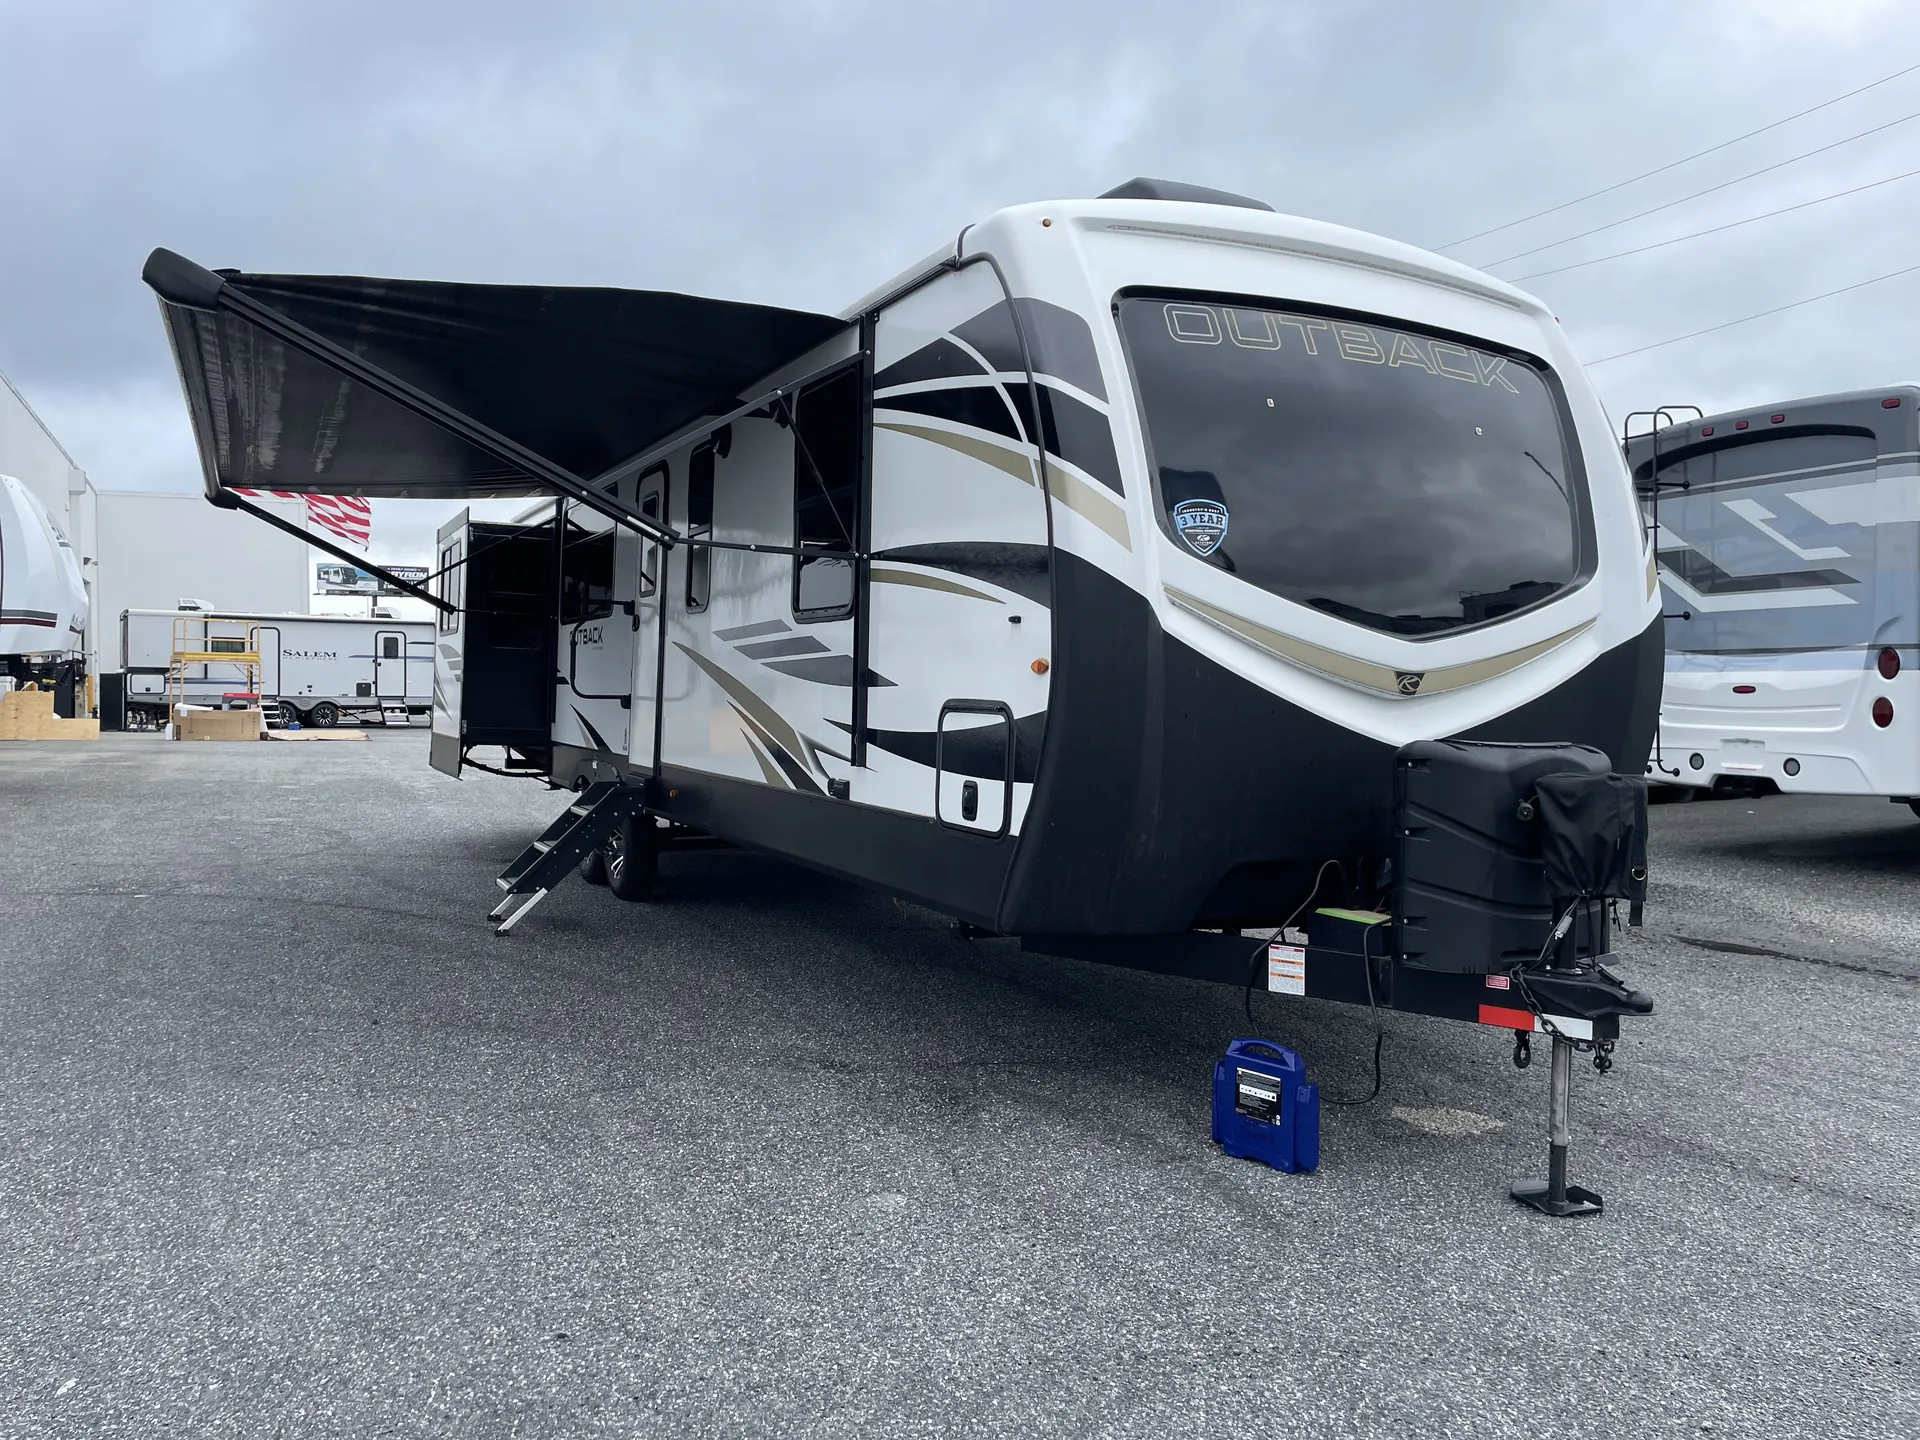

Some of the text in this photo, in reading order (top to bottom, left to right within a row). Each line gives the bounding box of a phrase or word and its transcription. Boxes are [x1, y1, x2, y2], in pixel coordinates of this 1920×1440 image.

[1164, 303, 1520, 393] OUTBACK
[1180, 513, 1224, 526] 3 YEAR
[282, 649, 337, 657] SALEM
